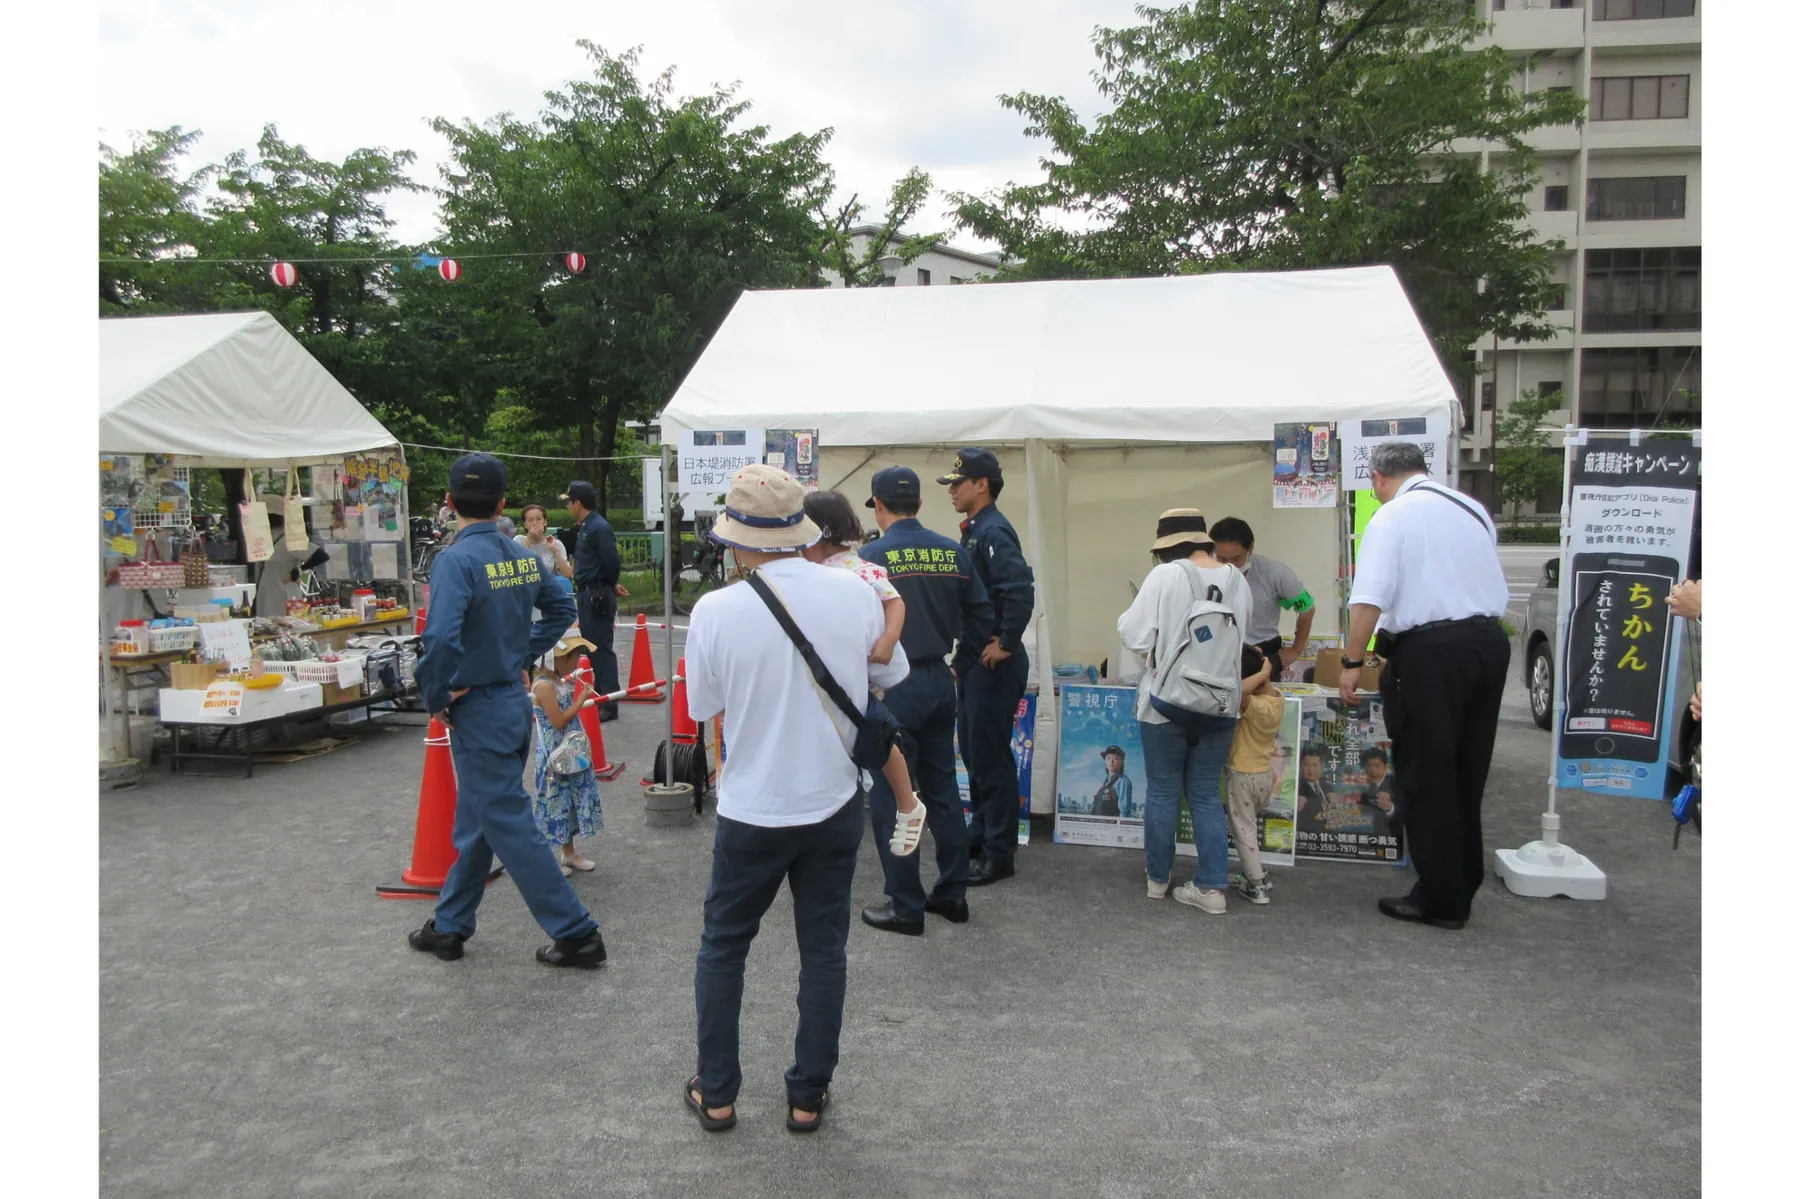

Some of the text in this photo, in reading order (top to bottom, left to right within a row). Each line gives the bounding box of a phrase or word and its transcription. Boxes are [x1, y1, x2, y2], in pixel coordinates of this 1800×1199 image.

[1584, 451, 1690, 475] 痴漢撲滅キャンペーン
[1601, 508, 1662, 518] ダウンロード
[1584, 524, 1676, 536] 周囲の方々の勇気が
[885, 547, 957, 564] 東京消防庁
[1617, 583, 1653, 671] ちかん
[1588, 580, 1613, 702] されていませんか？
[1067, 692, 1119, 709] 警視庁
[1307, 843, 1358, 853] 03-3593-7970
[1320, 833, 1357, 843] 甘い誘惑
[1359, 835, 1397, 846] 断つ勇気
